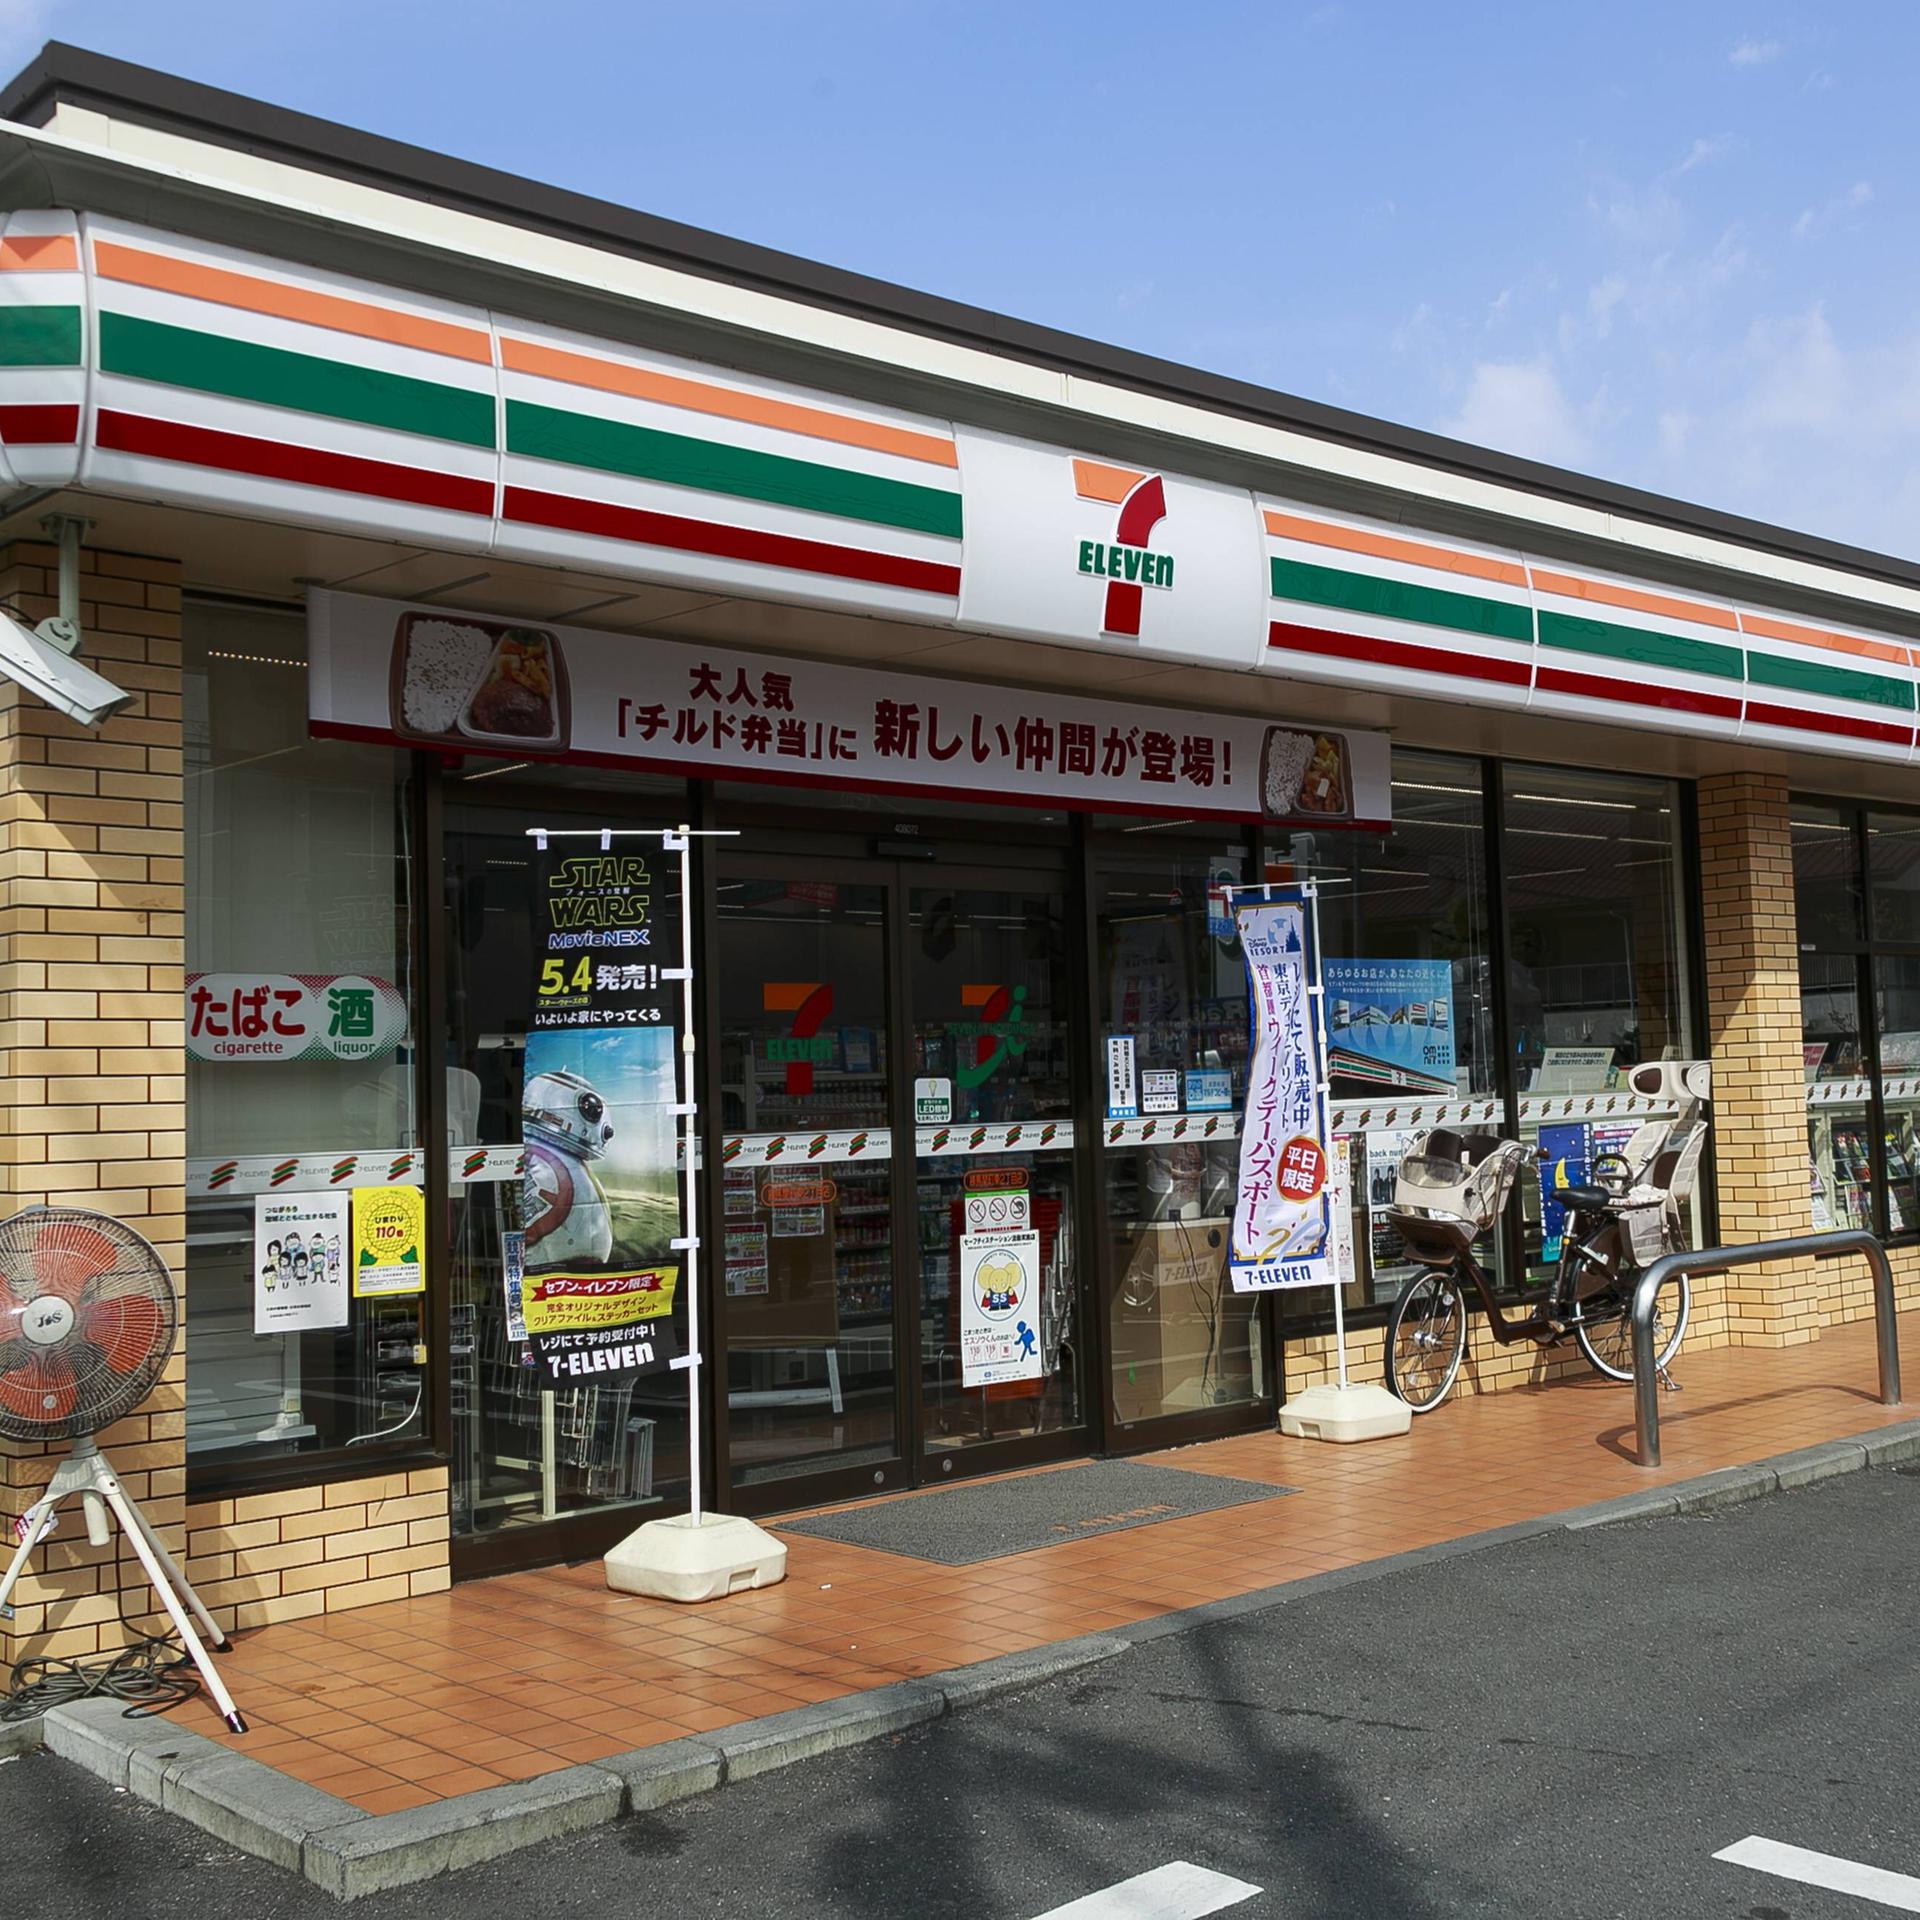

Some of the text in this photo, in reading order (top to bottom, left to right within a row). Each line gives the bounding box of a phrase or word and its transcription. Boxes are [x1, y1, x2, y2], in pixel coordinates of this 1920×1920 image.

[689, 662, 795, 712] 大人気
[617, 698, 1232, 786] 「チルド弁当」に 新しい仲間が登場!
[549, 856, 650, 888] STAR
[549, 895, 650, 928] WARS
[548, 929, 651, 950] MovieNEX
[537, 955, 658, 996] 5.4 発売!
[190, 985, 305, 1039] たばこ
[326, 987, 374, 1038] 酒
[535, 1008, 661, 1025] いよいよ家にやってくる
[213, 1040, 283, 1056] cigarette
[333, 1039, 376, 1056] liquor
[1290, 961, 1311, 1130] レジにて販売中
[1286, 1146, 1318, 1171] 平日
[1369, 1148, 1386, 1158] back
[1280, 1169, 1315, 1194] 限定
[546, 1296, 647, 1313] 完全オリジナルデザイン
[992, 1293, 1007, 1304] SS
[540, 1323, 656, 1351] レジにて予約受付中!
